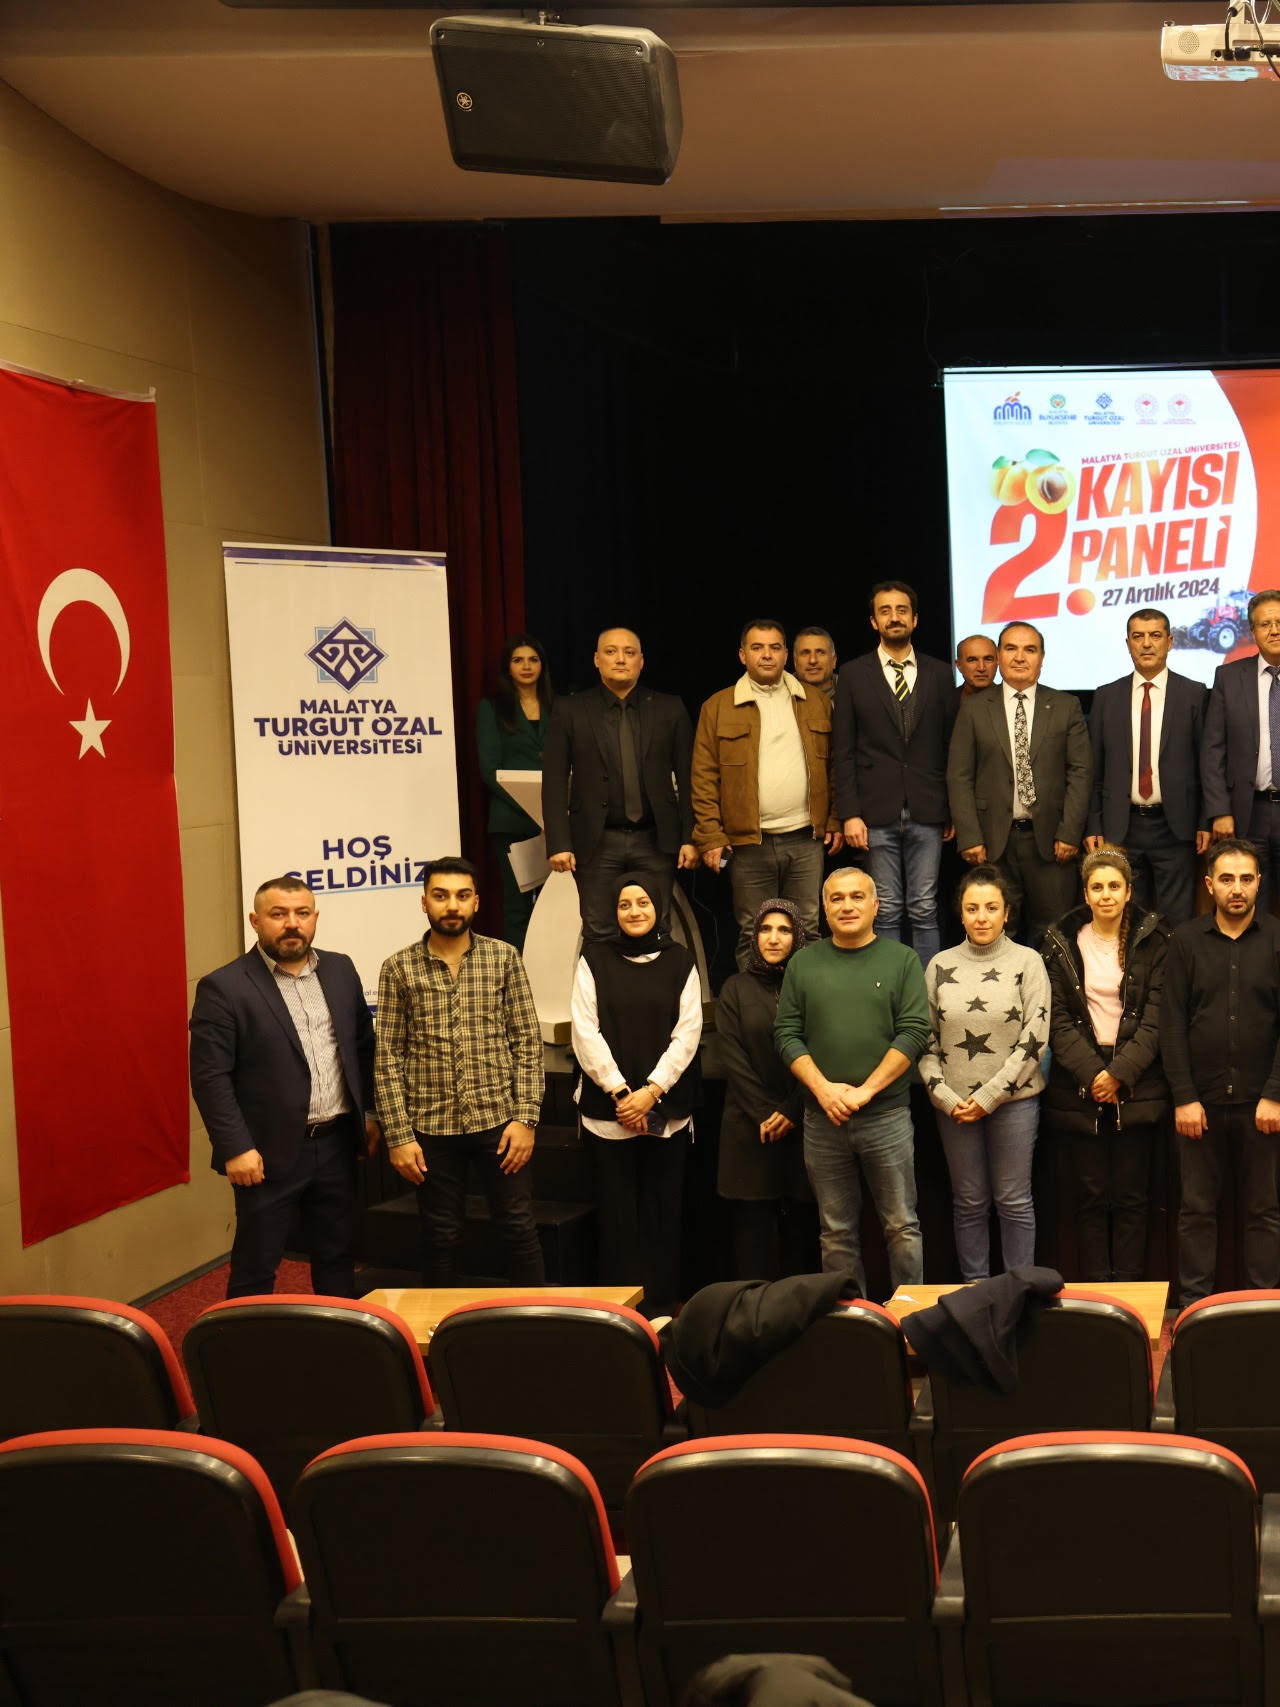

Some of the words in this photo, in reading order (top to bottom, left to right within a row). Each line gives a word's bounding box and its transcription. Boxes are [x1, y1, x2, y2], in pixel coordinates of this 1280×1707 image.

[1081, 454, 1122, 464] MALATYA
[1124, 450, 1158, 460] TURGUT
[1076, 451, 1240, 521] KAYISI
[1068, 515, 1231, 584] PANELİ
[1102, 588, 1124, 607] 27
[1125, 582, 1175, 605] Aralık
[1177, 577, 1220, 599] 2024
[300, 699, 397, 714] MALATYA
[254, 717, 363, 736] TURGUT
[371, 716, 442, 736] ÖZAL
[278, 738, 422, 755] ÜNİVERSİTESİ
[322, 835, 392, 861] HOŞ
[284, 857, 430, 890] ELDİNİZ
